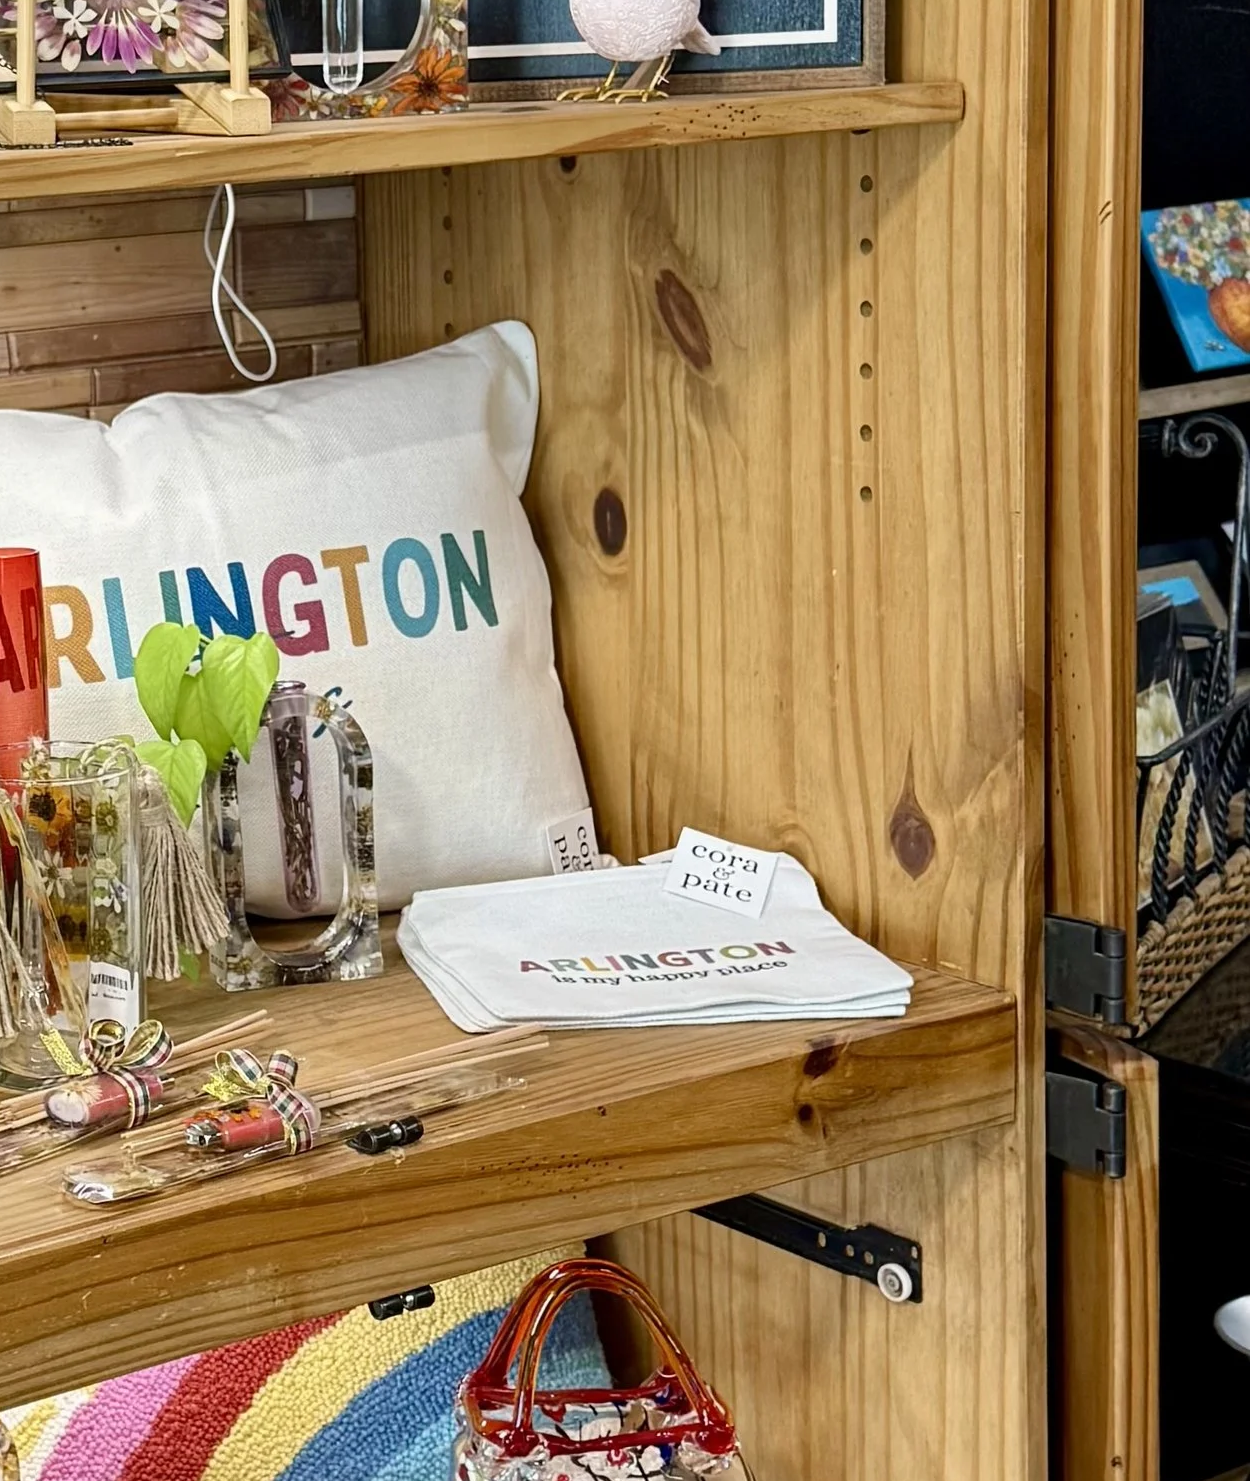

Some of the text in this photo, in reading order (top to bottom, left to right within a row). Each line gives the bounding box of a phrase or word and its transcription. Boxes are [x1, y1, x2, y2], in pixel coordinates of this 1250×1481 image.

[554, 833, 570, 871] pa
[577, 826, 594, 871] cor
[691, 844, 759, 875] cora
[680, 873, 753, 903] pate
[712, 866, 736, 881] &
[520, 940, 797, 973] ARLINGTON
[551, 960, 789, 986] is my happy place
